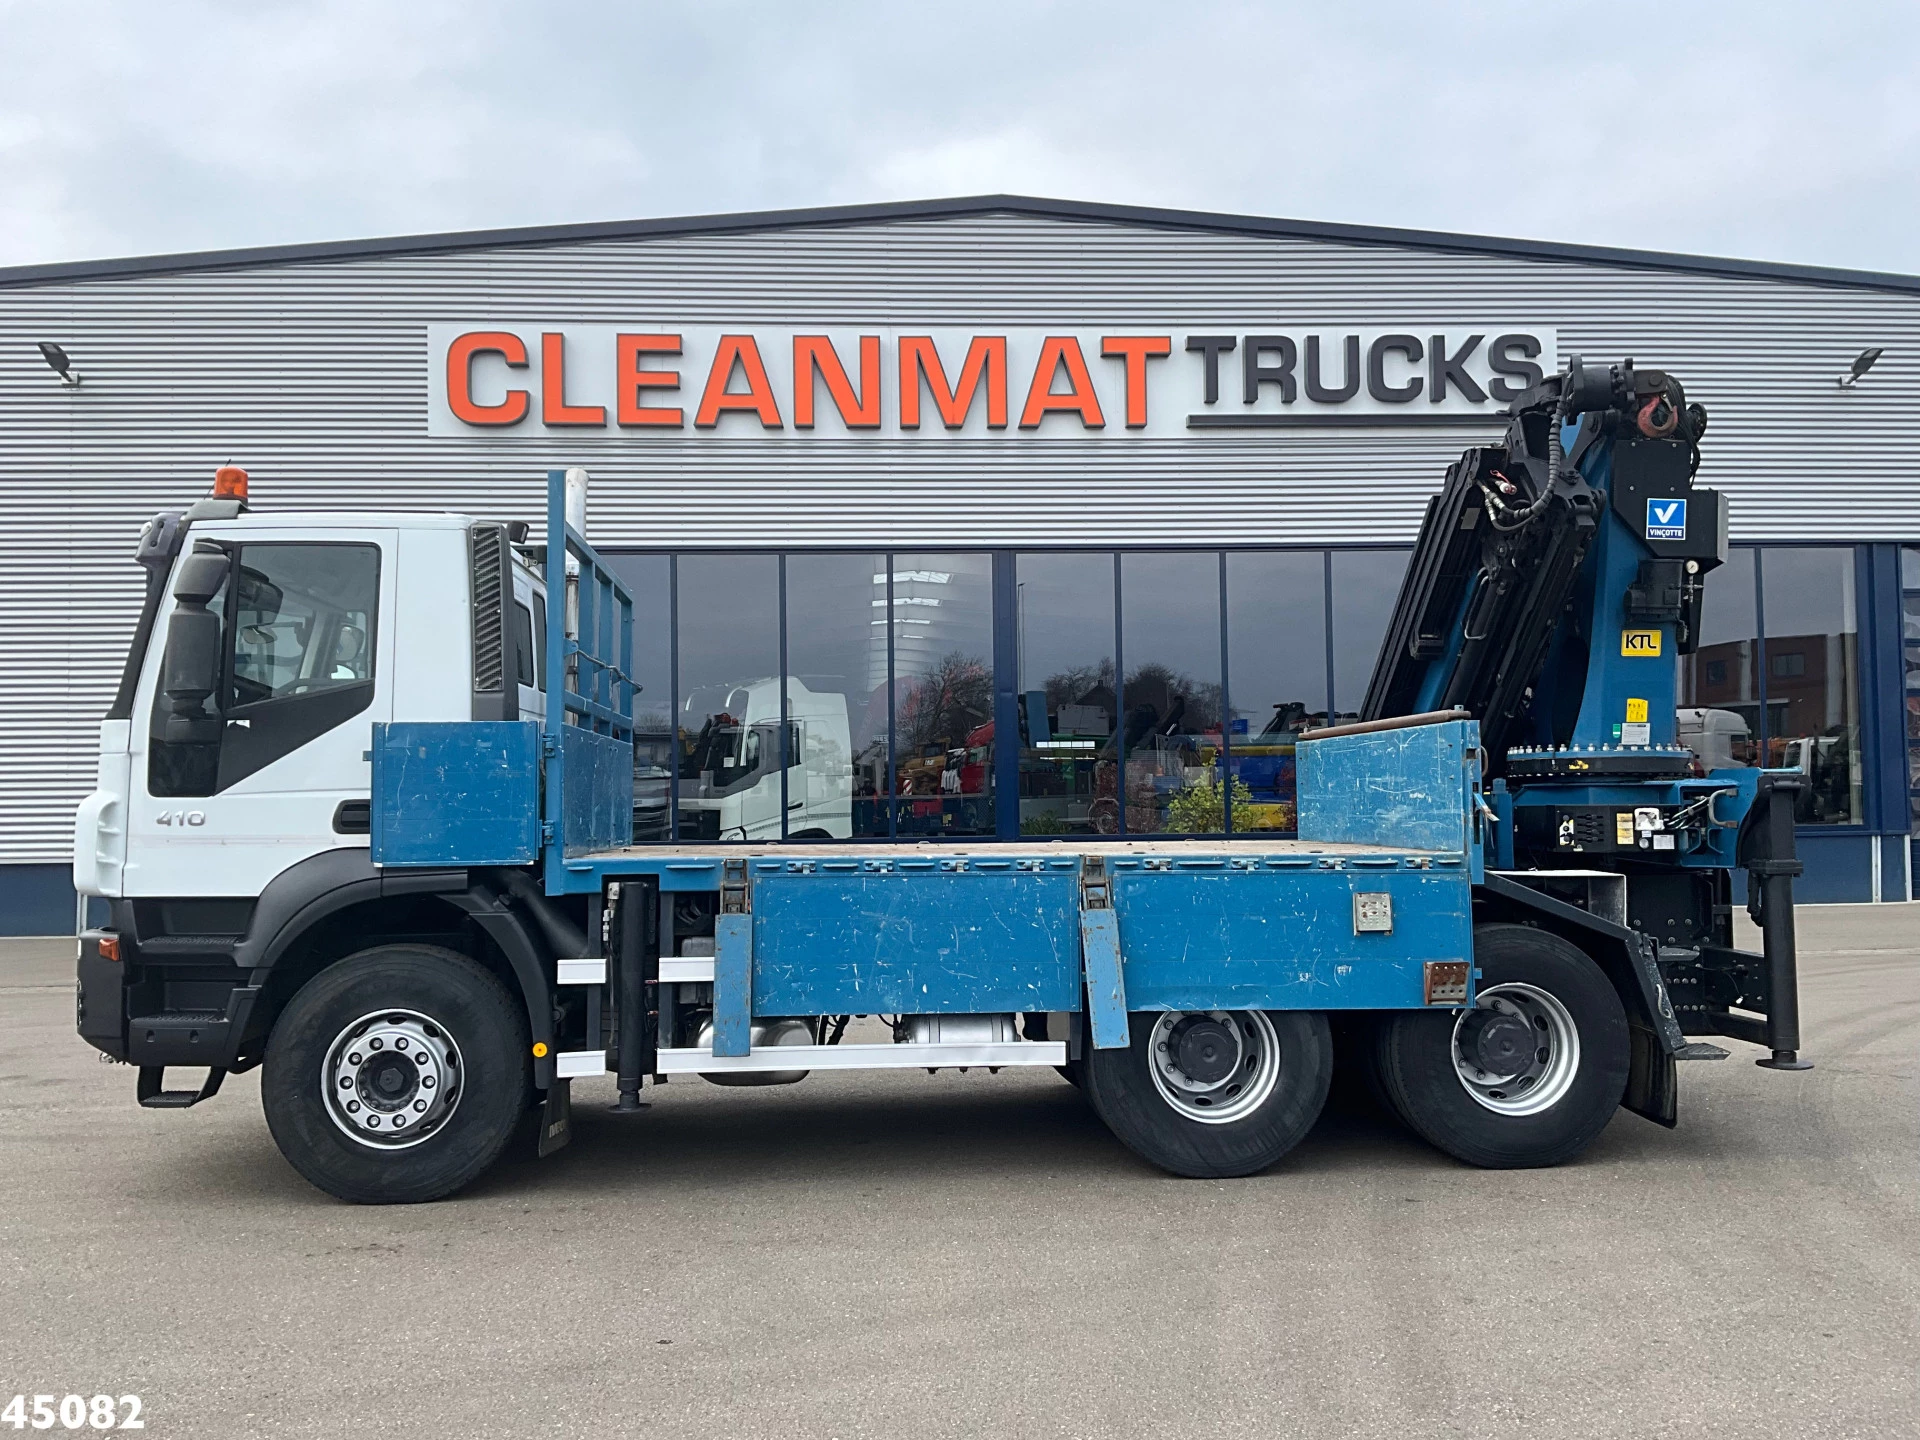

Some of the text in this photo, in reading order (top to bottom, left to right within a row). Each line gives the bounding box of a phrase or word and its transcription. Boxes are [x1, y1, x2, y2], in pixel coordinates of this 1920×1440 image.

[446, 331, 1544, 431] CLEANMAT TRUCKS
[1649, 528, 1683, 538] VINÇOTTE
[1625, 634, 1657, 649] KTL
[156, 810, 206, 827] 410
